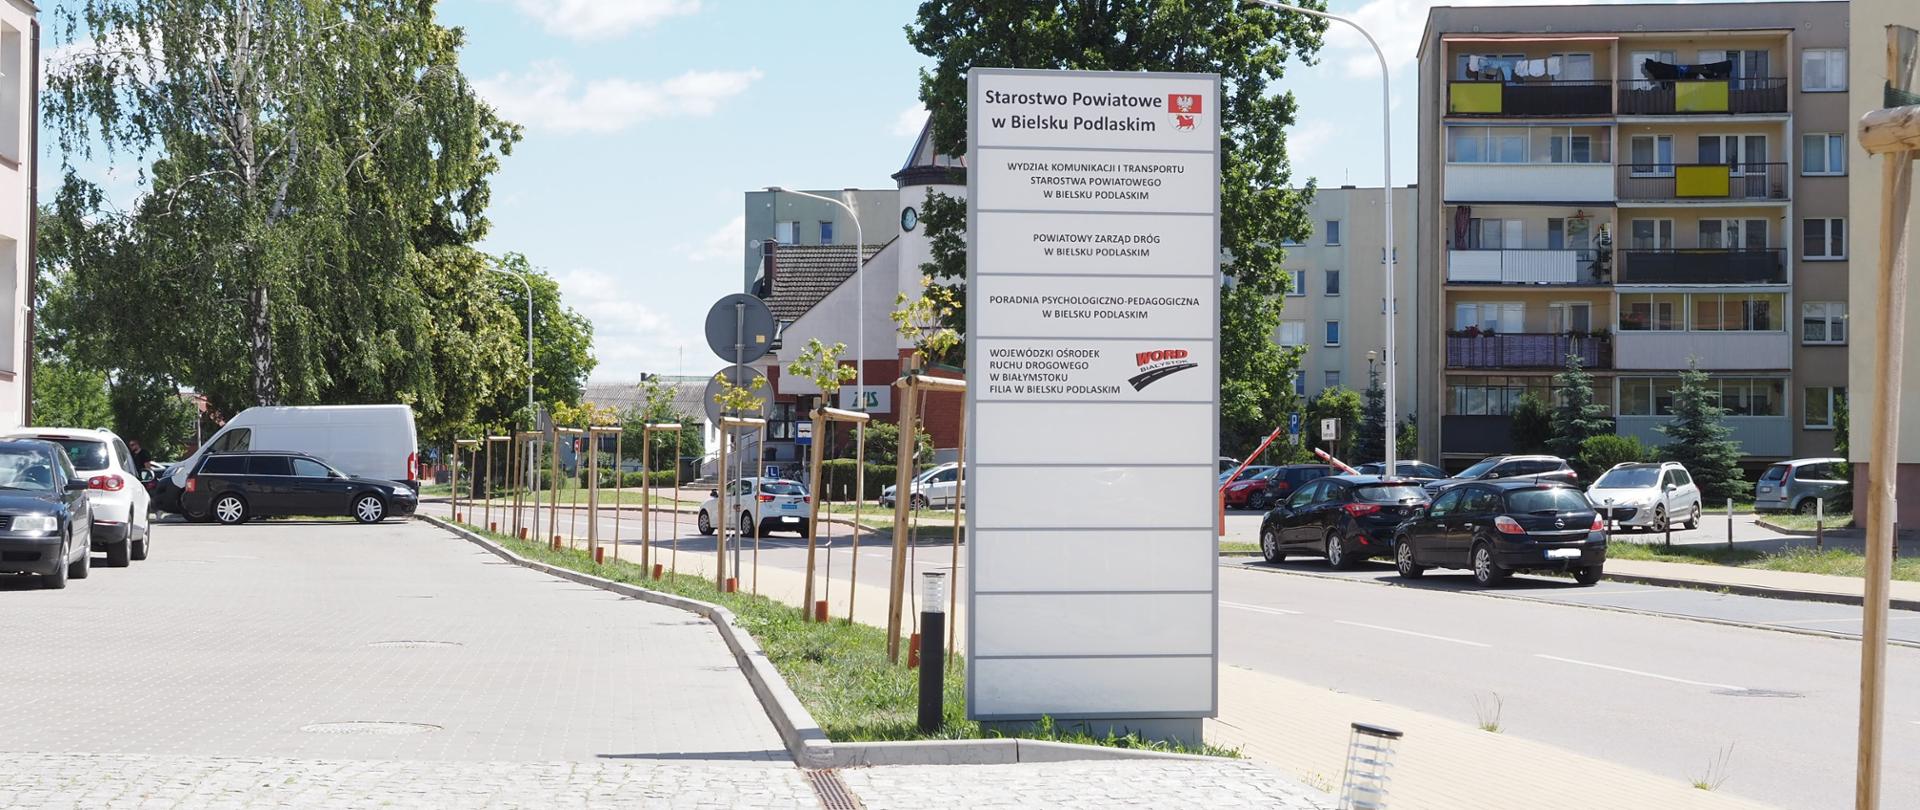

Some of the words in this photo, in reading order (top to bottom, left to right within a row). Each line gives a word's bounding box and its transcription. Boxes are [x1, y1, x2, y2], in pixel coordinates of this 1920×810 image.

[986, 90, 1067, 105] Starostwo
[1073, 92, 1162, 107] Powiatowe
[992, 118, 1005, 128] w
[1012, 115, 1068, 129] Bielsku
[1074, 116, 1155, 131] Podlaskim
[1008, 162, 1048, 172] WYDZIAŁ
[1052, 162, 1115, 173] KOMUNIKACJI
[1117, 164, 1121, 173] I
[1123, 164, 1184, 174] TRANSPORTU
[1031, 176, 1086, 186] STAROSTWA
[1089, 177, 1161, 187] POWIATOWEGO
[1043, 189, 1053, 199] W
[1056, 190, 1092, 200] BIELSKU
[1095, 190, 1149, 200] PODLASKIM
[1034, 233, 1092, 243] POWIATOWY
[1095, 234, 1131, 245] ZARZĄD
[1134, 233, 1160, 244] DRÓG
[1044, 247, 1053, 256] W
[1057, 247, 1093, 257] BIELSKU
[1096, 248, 1149, 257] PODLASKIM
[990, 295, 1039, 305] PORADNIA
[1042, 295, 1199, 306] PSYCHOLOGICZNO-PEDAGOGICZNA
[1042, 309, 1052, 318] W
[1055, 309, 1091, 319] BIELSKU
[1094, 310, 1147, 320] PODLASKIM
[990, 347, 1053, 358] WOJEWÓDZKI
[1056, 347, 1099, 359] OŚRODEK
[1136, 349, 1188, 366] WORD
[990, 360, 1022, 370] RUCHU
[1026, 360, 1088, 370] DROGOWEGO
[990, 372, 999, 382] W
[1003, 372, 1068, 383] BIAŁYMSTOKU
[990, 384, 1011, 394] FILIA
[1014, 385, 1024, 394] W
[1027, 385, 1063, 394] BIELSKU
[1067, 385, 1120, 394] PODLASKIM
[1291, 414, 1297, 427] P
[770, 468, 776, 476] L
